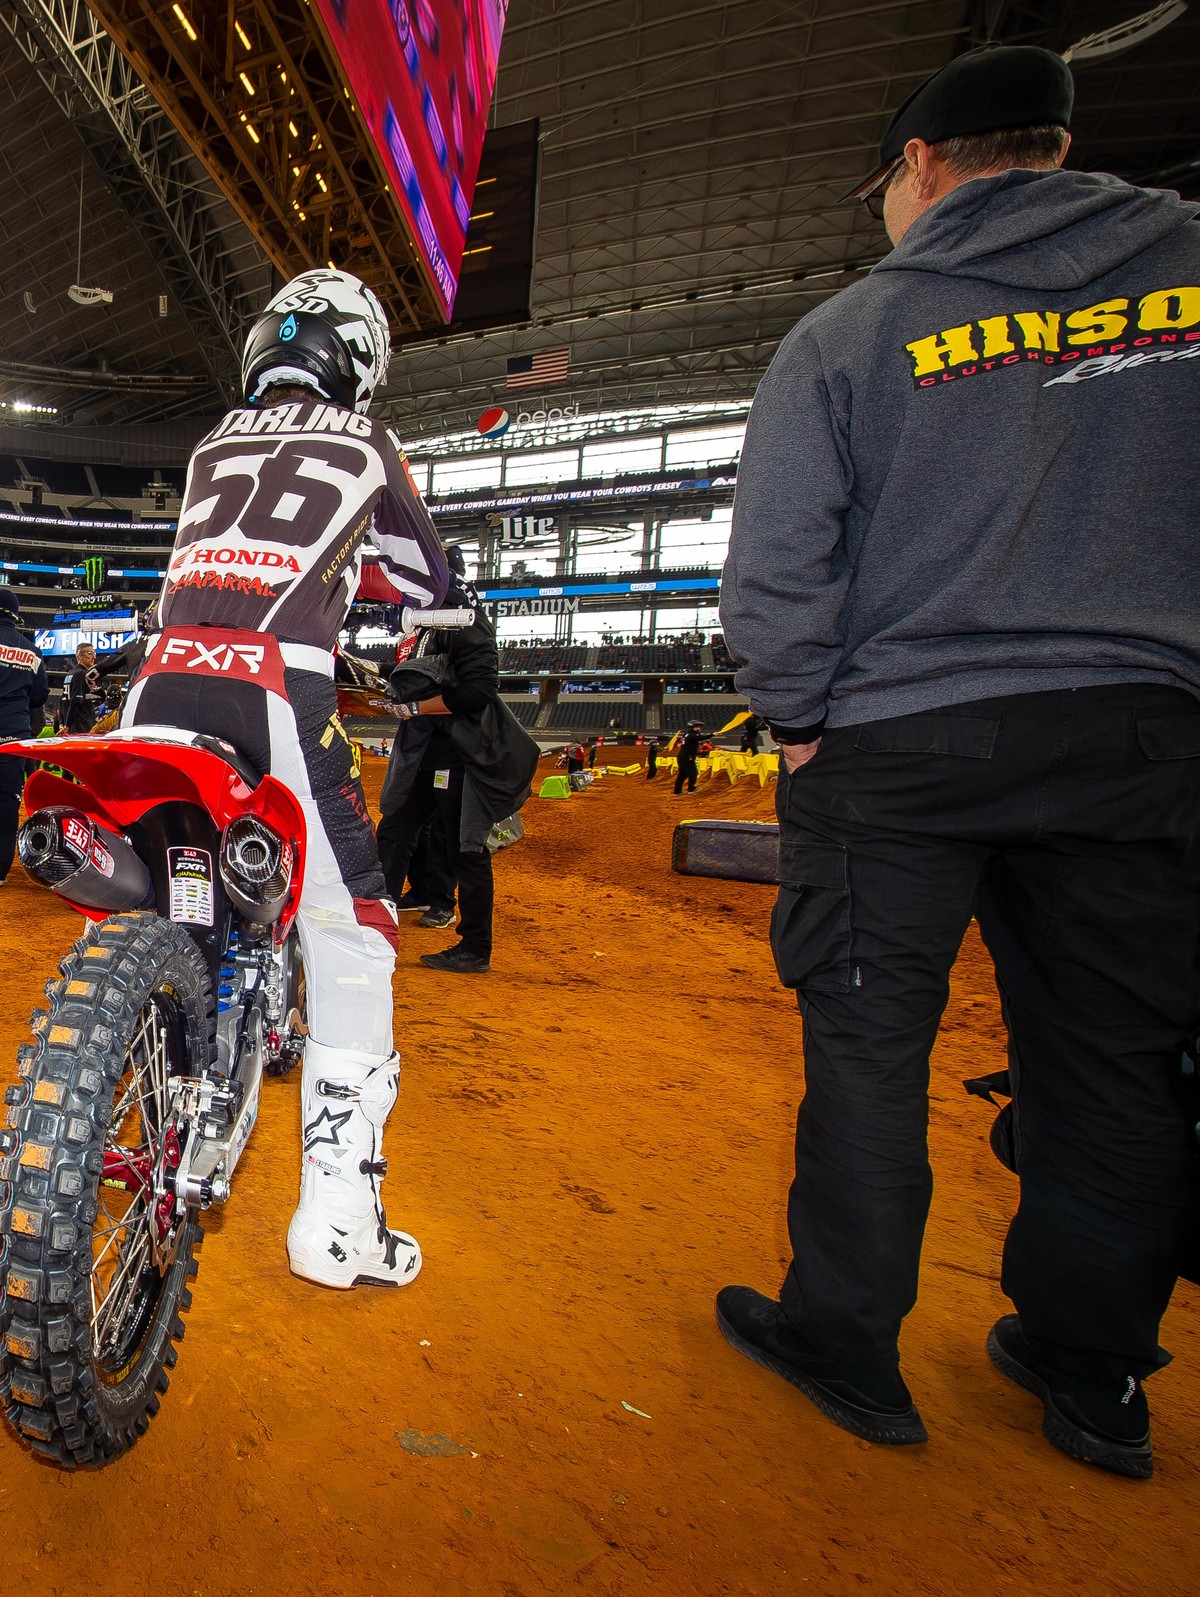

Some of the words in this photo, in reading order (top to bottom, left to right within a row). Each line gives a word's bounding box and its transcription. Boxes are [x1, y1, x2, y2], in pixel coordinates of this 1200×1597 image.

[442, 274, 453, 305] AM
[906, 286, 1200, 377] HINSO
[919, 351, 1039, 387] CLUTCH
[200, 403, 373, 447] TARLING
[517, 403, 580, 432] pepsi
[176, 439, 368, 550] 56
[442, 502, 462, 512] EVERY
[463, 499, 496, 511] COWBOYS
[497, 496, 530, 507] GAMEDAY
[531, 494, 552, 503] WHEN
[553, 491, 570, 500] YOU
[570, 490, 591, 500] WEAR
[592, 488, 613, 497] YOUR
[615, 484, 651, 496] COWBOYS
[651, 481, 683, 492] JERSEY
[20, 515, 36, 523] EVERY
[35, 516, 57, 525] COWBOYS
[57, 519, 79, 527] GAMEDAY
[93, 521, 104, 529] YOU
[500, 516, 555, 543] Lite
[193, 548, 303, 574] HONDA
[321, 538, 354, 584] FACTORY
[353, 514, 370, 541] RIDE
[71, 594, 113, 605] MONSTER
[497, 597, 580, 617] STADIUM
[53, 609, 132, 623] SUPERCROSS
[61, 630, 124, 651] FINISH
[11, 664, 33, 673] SERVIC
[161, 637, 265, 674] FXR
[66, 819, 90, 849] ヨシムラ
[175, 862, 207, 873] FXR
